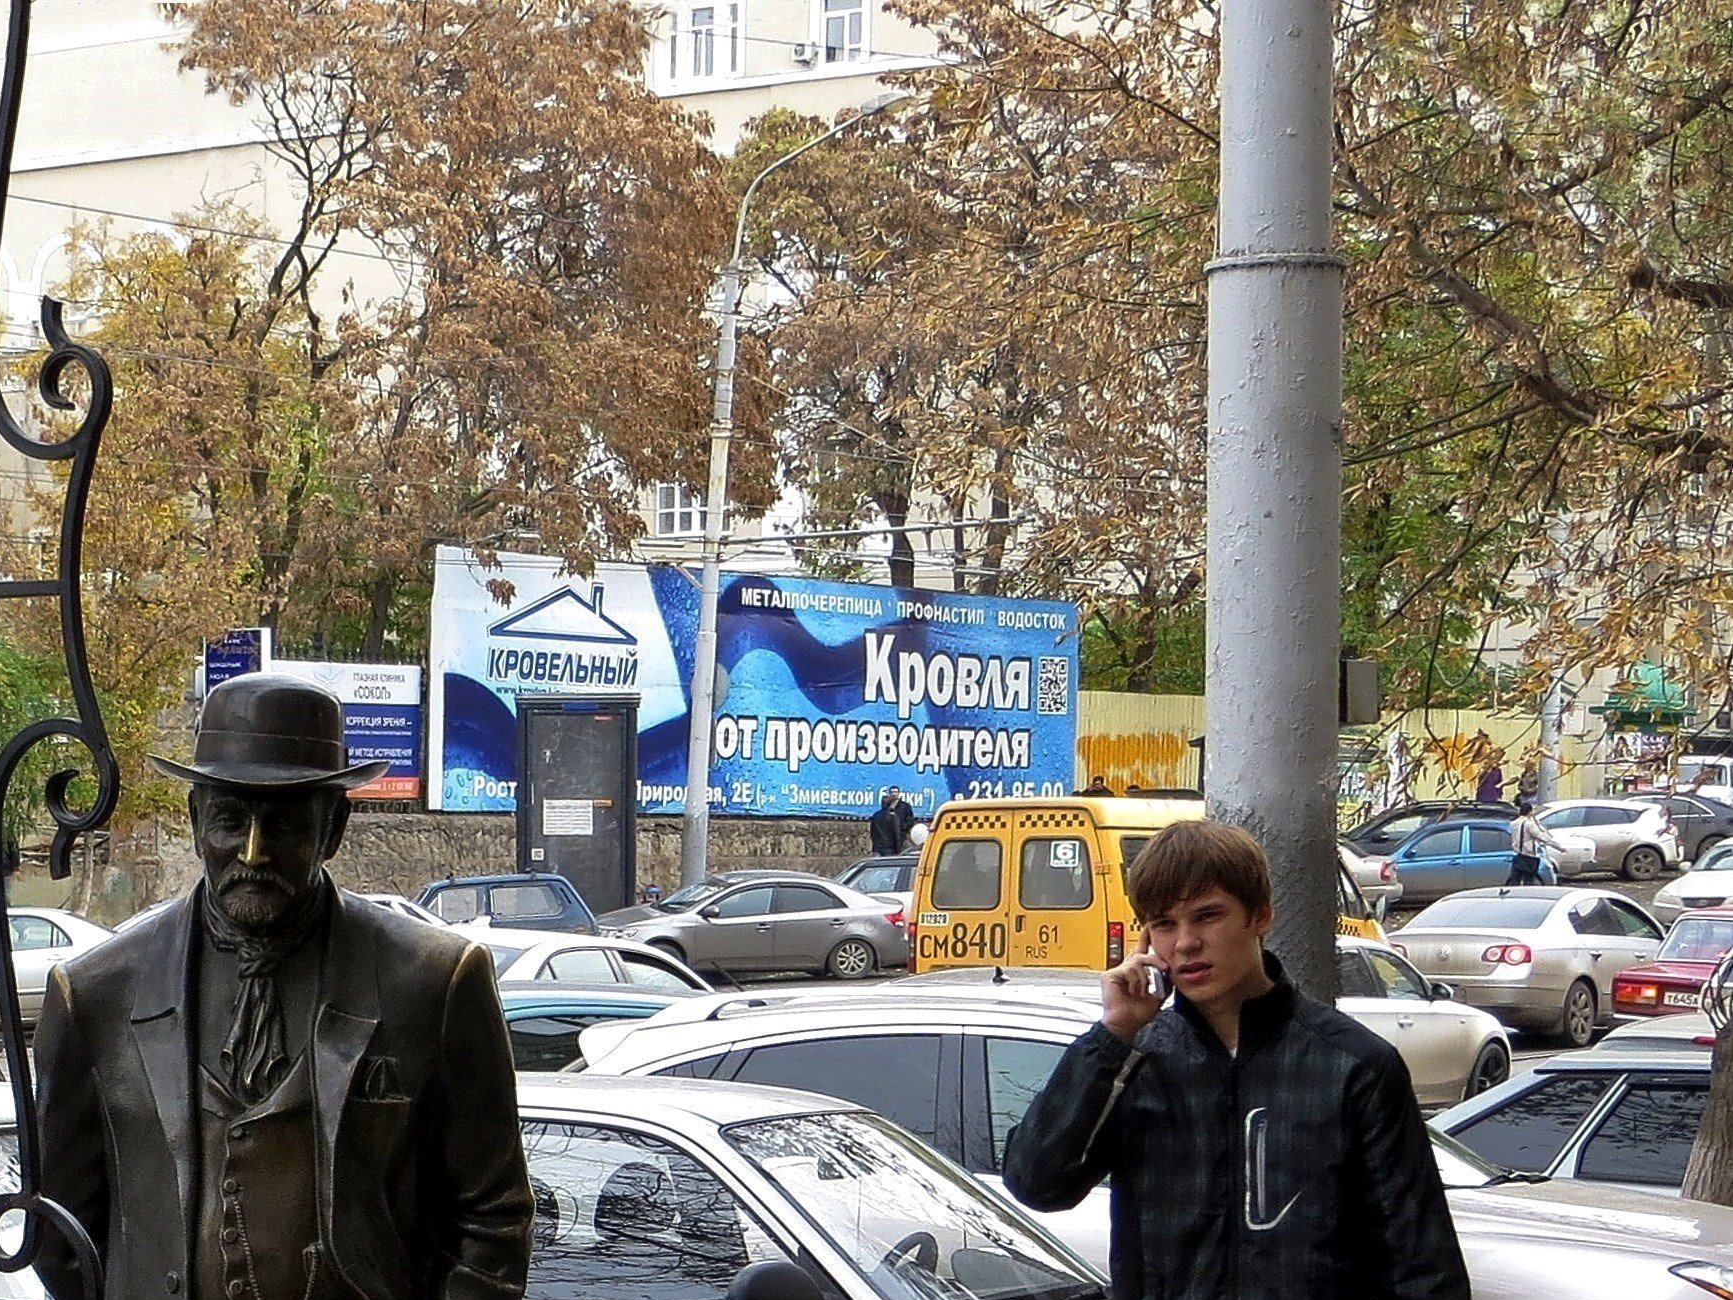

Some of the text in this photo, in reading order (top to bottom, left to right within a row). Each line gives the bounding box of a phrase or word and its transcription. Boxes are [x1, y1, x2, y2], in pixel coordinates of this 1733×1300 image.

[740, 588, 1066, 631] МЕТАЛЛОЧЕРЕПИЦА ПРОФНАСТИЛ ВОДОСТОК
[487, 647, 639, 687] КРОВЕЛЬНЫЙ
[864, 632, 1033, 719] Кровля
[715, 717, 1032, 774] от производителя
[1025, 945, 1049, 959] RUS
[1038, 924, 1059, 944] 61
